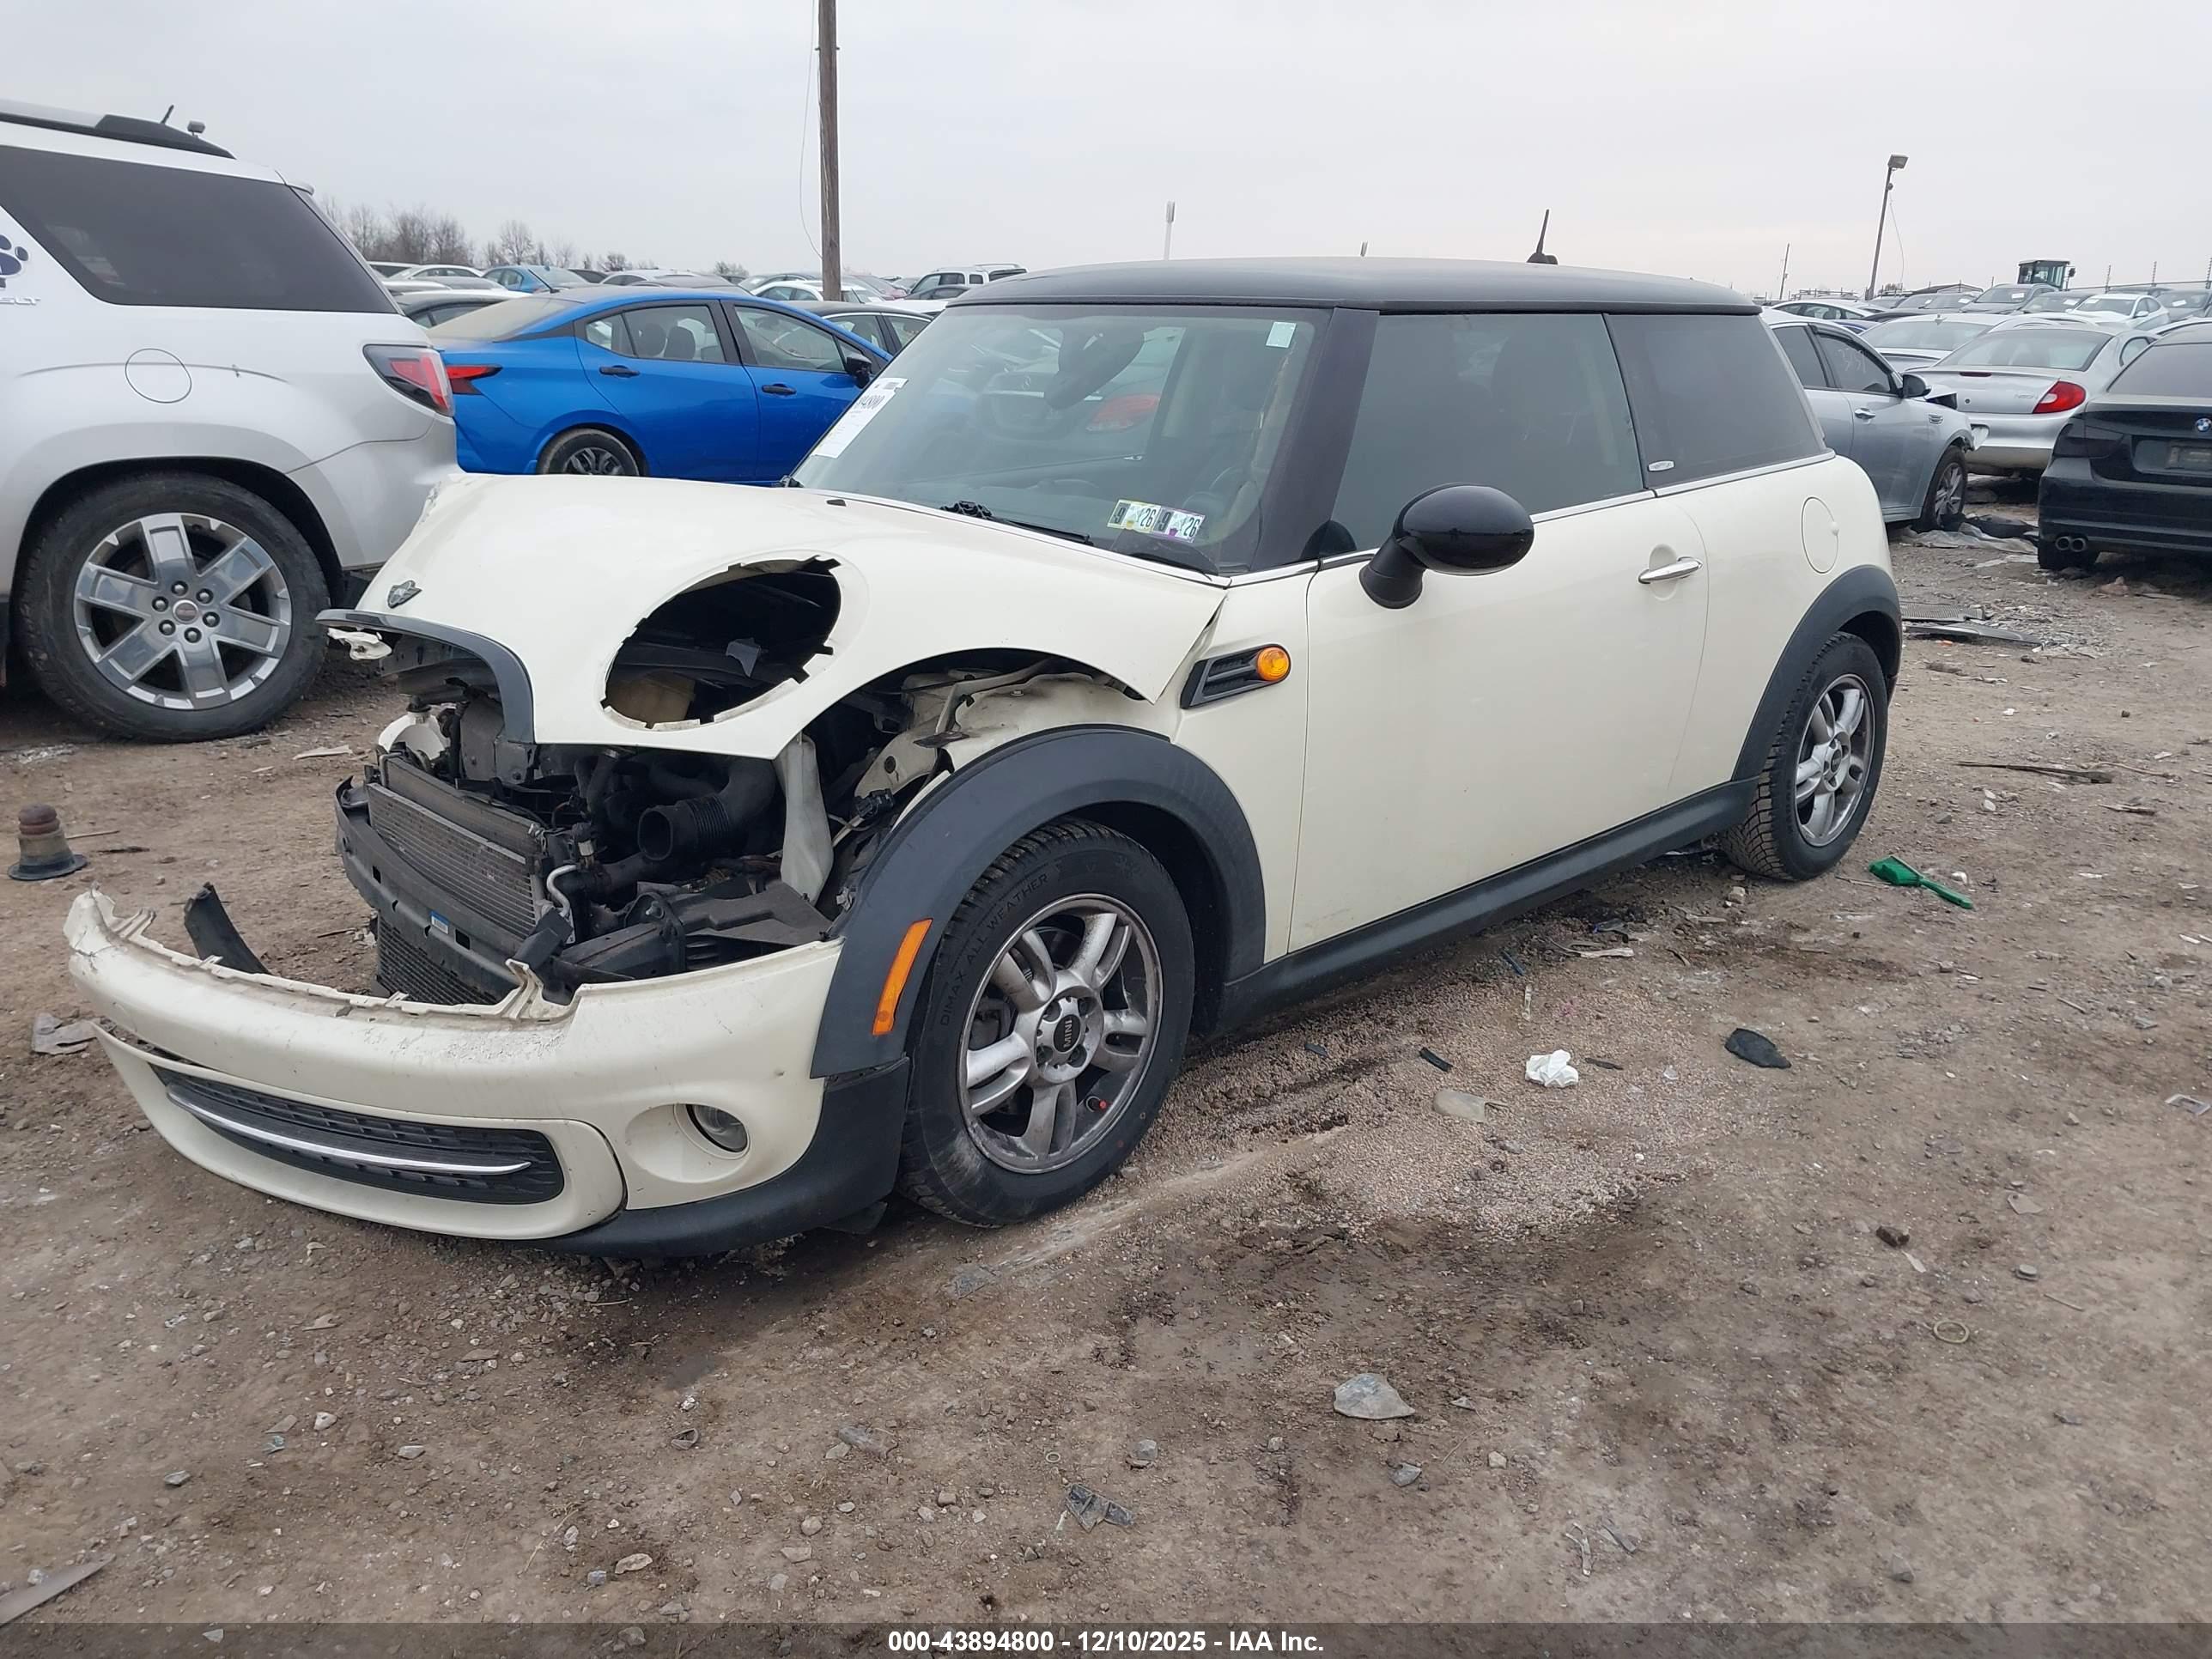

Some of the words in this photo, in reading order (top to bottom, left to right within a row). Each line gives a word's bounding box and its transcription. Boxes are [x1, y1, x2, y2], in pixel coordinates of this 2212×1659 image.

[1140, 507, 1157, 527] 26
[1183, 517, 1200, 537] 26
[940, 971, 968, 1026] DIMAX
[967, 937, 989, 965] ALL
[987, 872, 1049, 930] WEATHER
[1063, 1019, 1073, 1048] MINI
